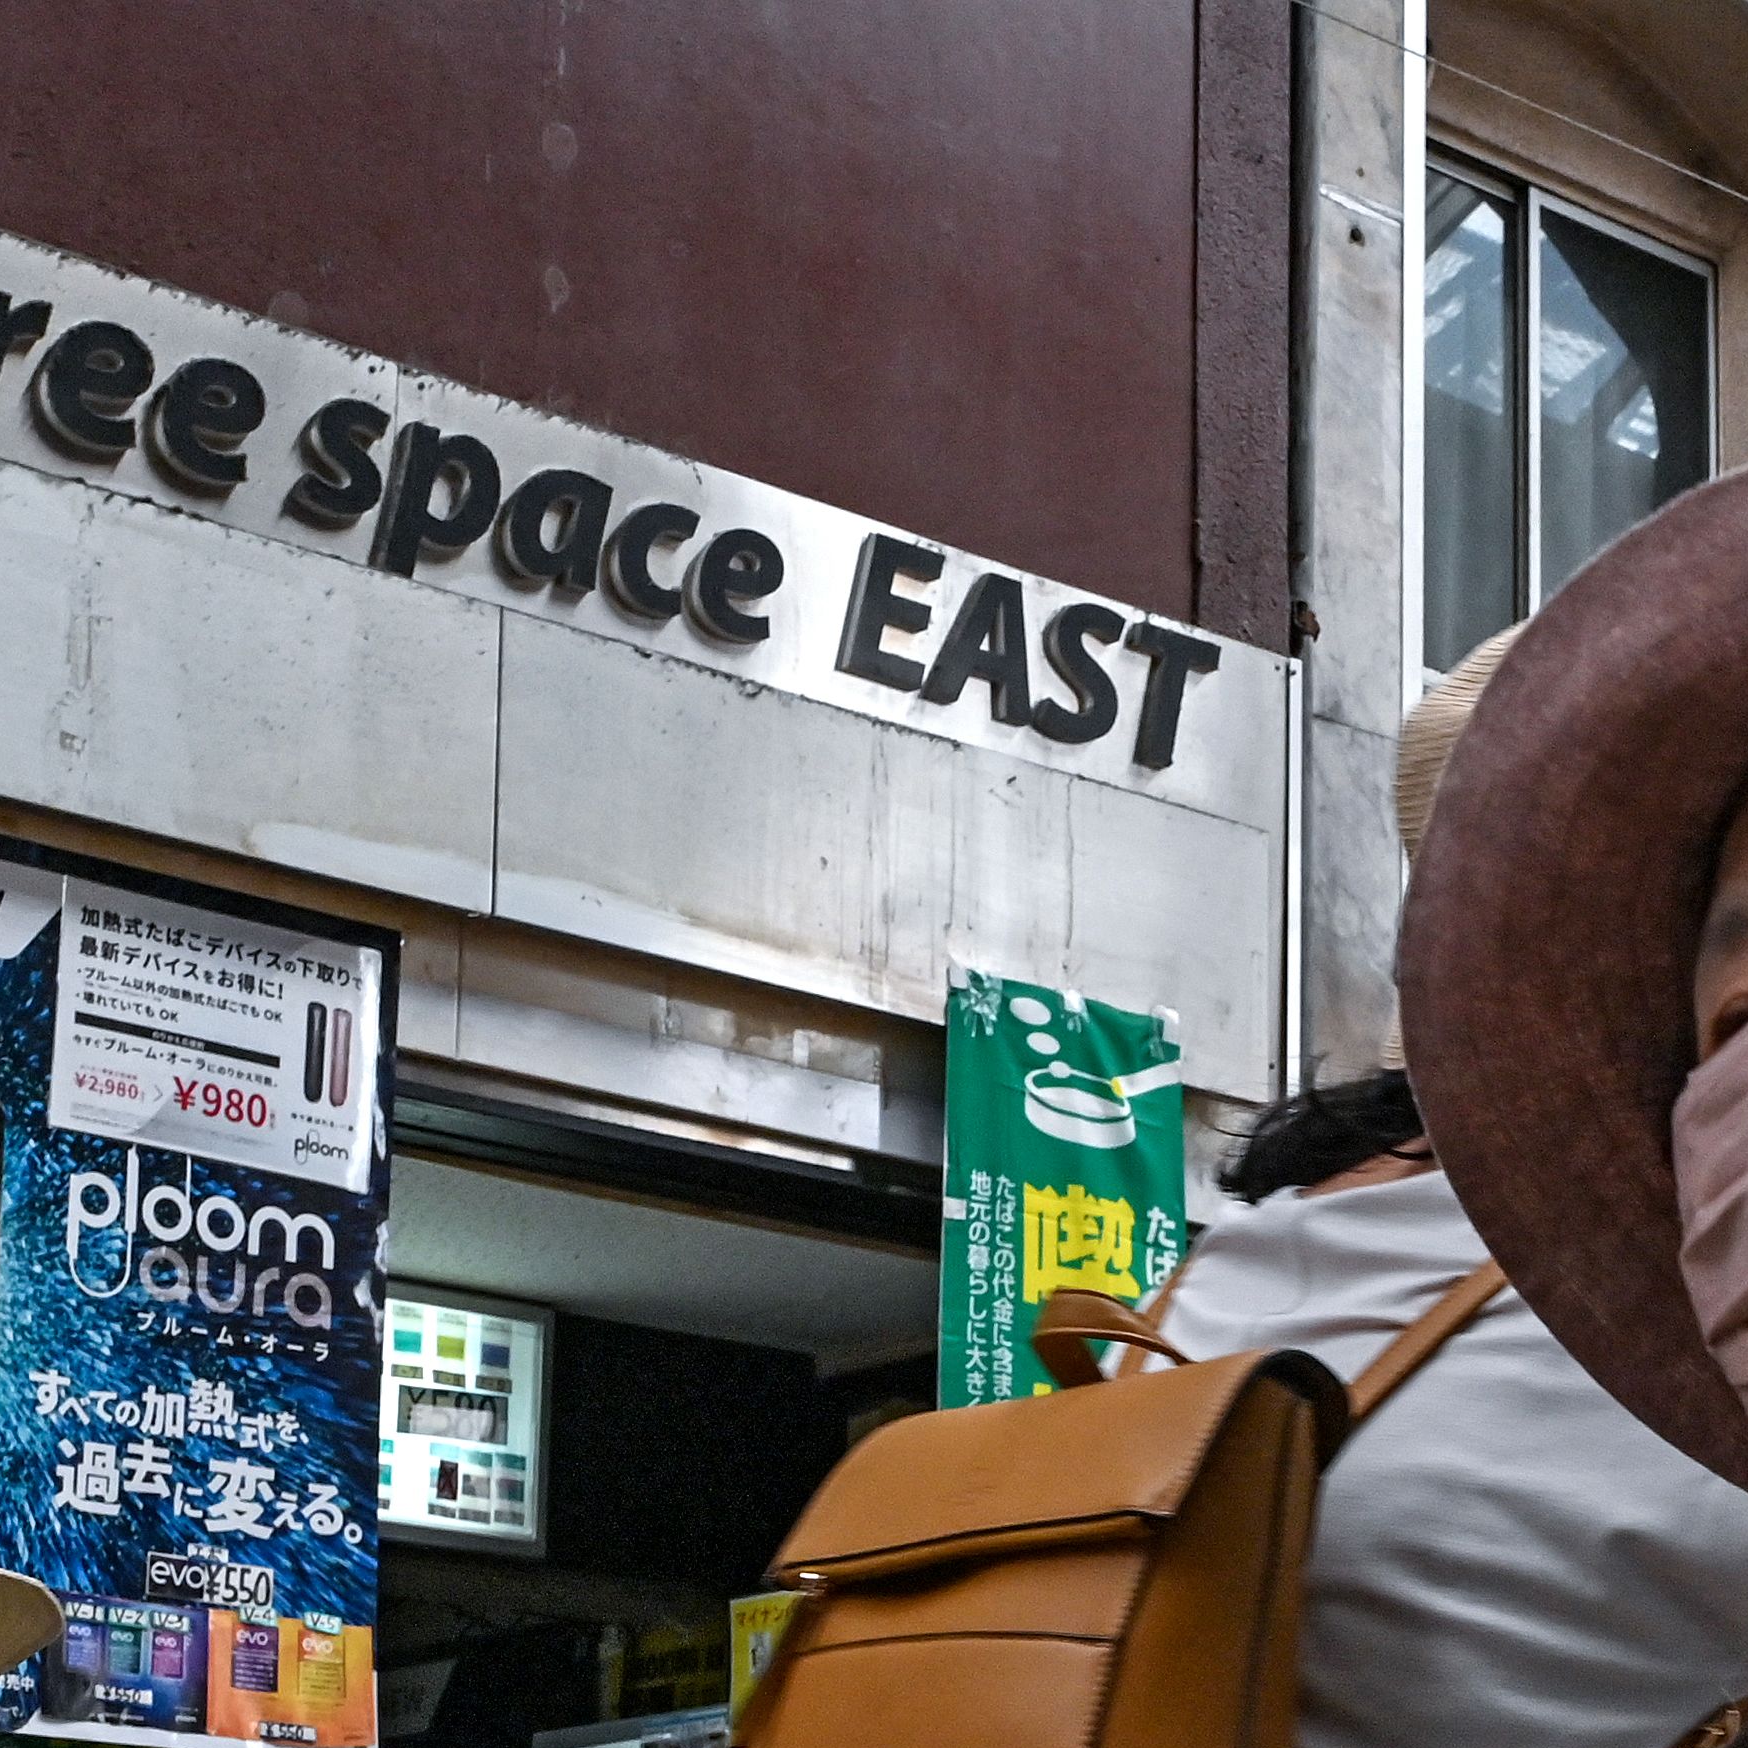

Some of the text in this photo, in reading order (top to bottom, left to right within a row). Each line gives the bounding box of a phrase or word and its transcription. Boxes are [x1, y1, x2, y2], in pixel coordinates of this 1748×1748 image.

[283, 396, 787, 648] space
[833, 530, 1223, 770] EAST
[79, 935, 284, 1001] 最新デバイスをお得に!
[159, 1008, 179, 1023] OK
[263, 1008, 283, 1024] OK
[73, 1071, 139, 1100] ¥2,980
[172, 1075, 268, 1128] ¥980
[293, 1129, 350, 1164] ploom
[65, 1144, 336, 1298] ploom
[138, 1243, 332, 1331] aura
[992, 1174, 1017, 1402] たばこの代金に含ま
[137, 1310, 330, 1362] プルーム・オーラ
[29, 1368, 311, 1453] すべての加熱式を、
[55, 1439, 364, 1545] 過去に変える。
[150, 1559, 271, 1608] evo ¥550
[235, 1628, 269, 1646] evo
[303, 1637, 335, 1654] evo
